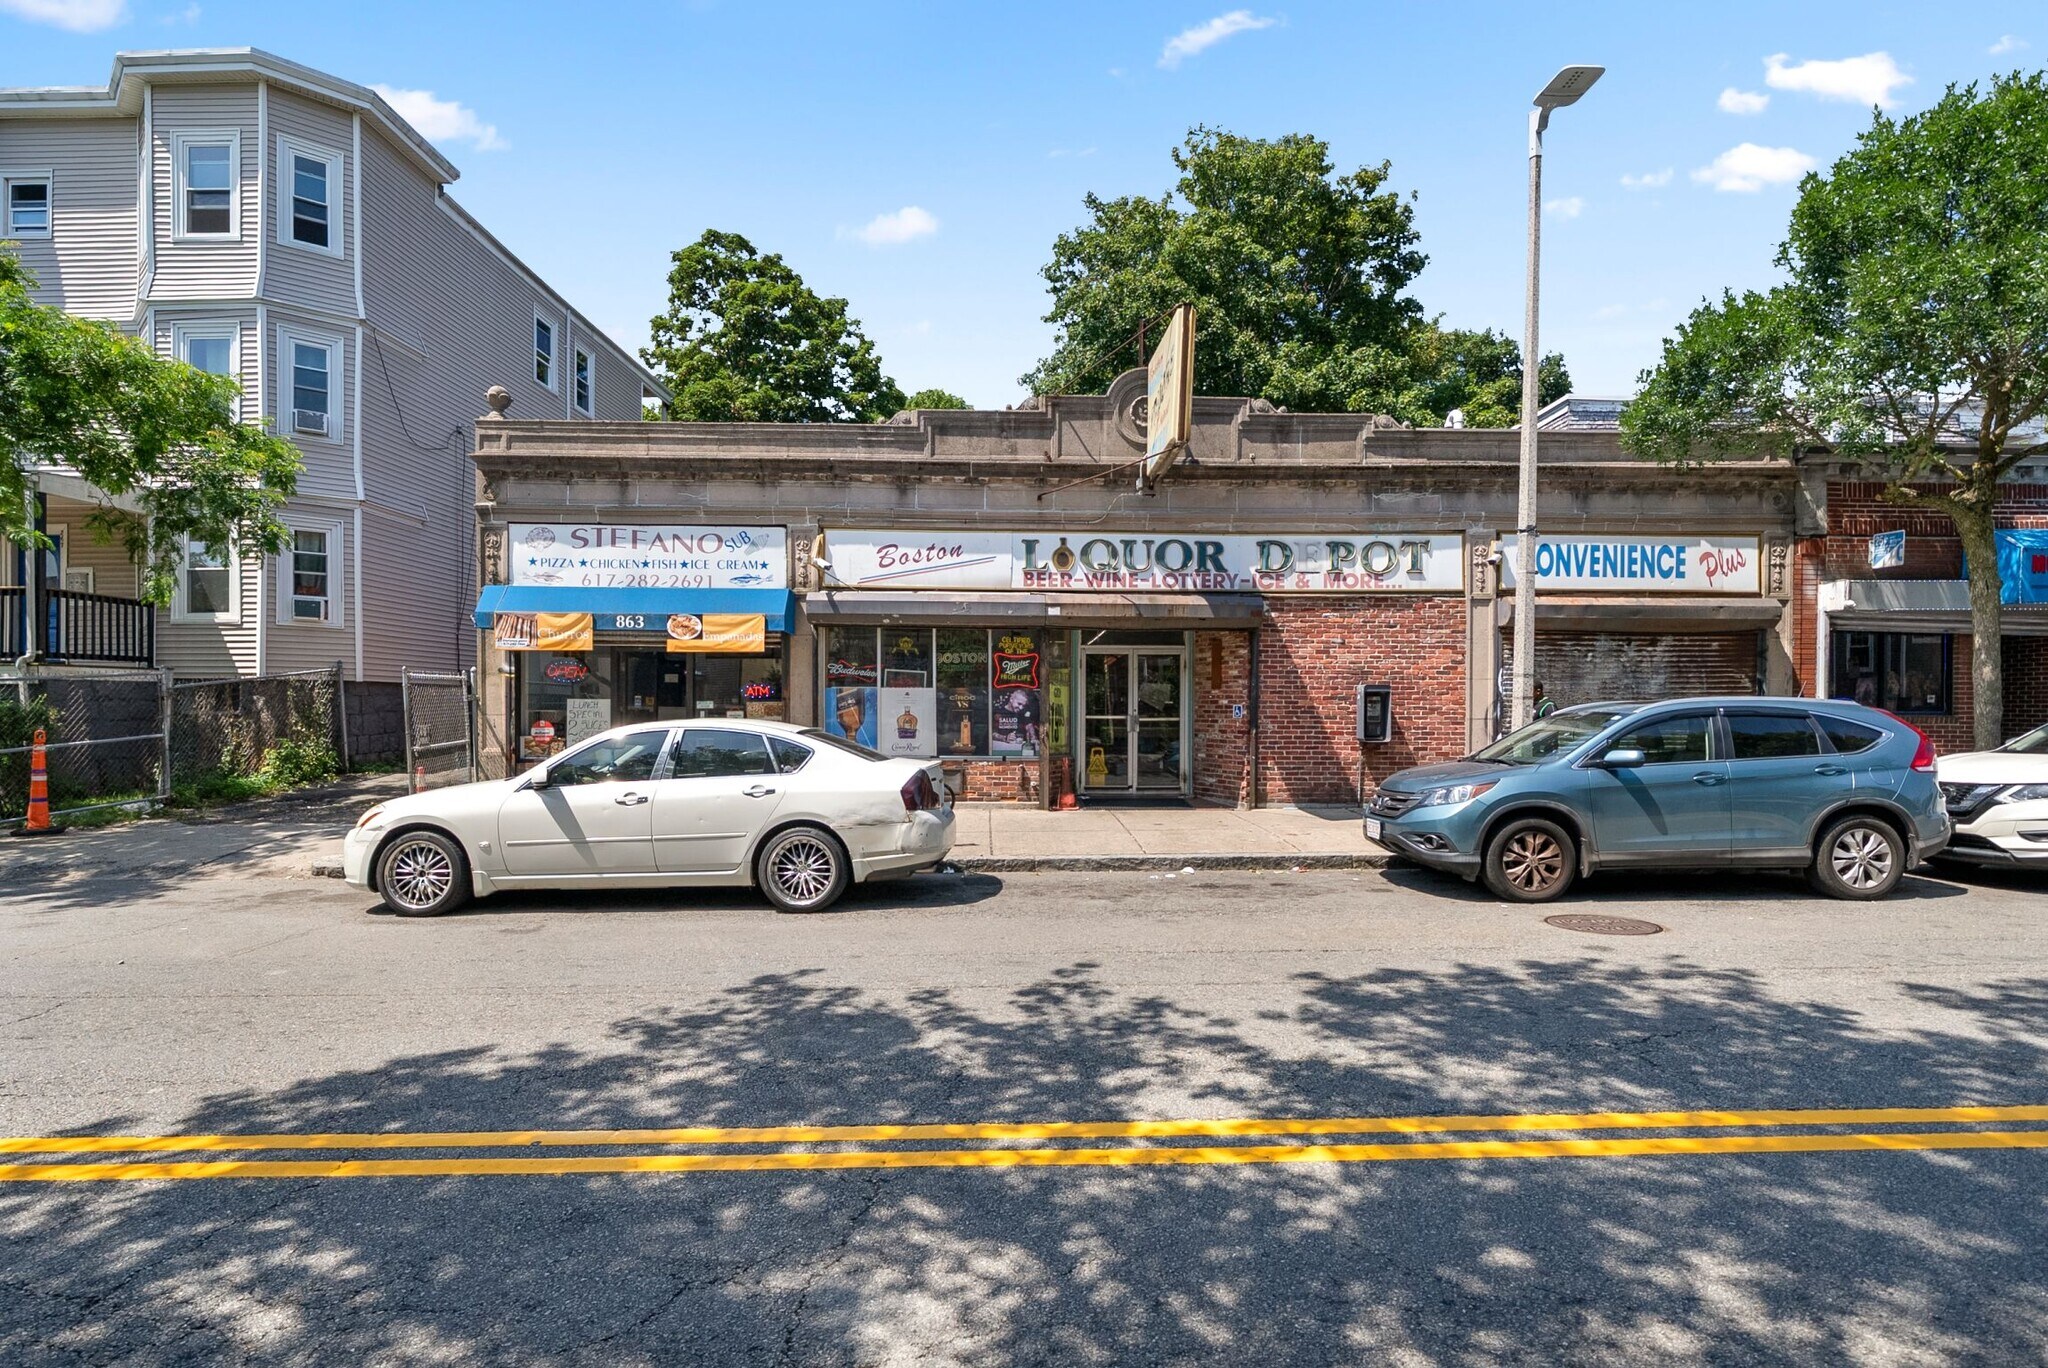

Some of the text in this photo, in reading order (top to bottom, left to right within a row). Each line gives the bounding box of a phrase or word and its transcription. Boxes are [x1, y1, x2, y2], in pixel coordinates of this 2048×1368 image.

[570, 527, 751, 555] STEFANO SUB
[876, 543, 964, 569] Boston
[540, 557, 759, 571] PIZZA CHICKEN FISH ICE CREAM
[1535, 543, 1746, 587] ONVENIENCE Plus
[581, 573, 713, 588] 617-282-2691
[1295, 574, 1310, 589] &
[616, 614, 645, 629] 863
[537, 627, 590, 640] Churros
[547, 665, 588, 679] OPEN
[746, 685, 770, 697] ATM
[572, 701, 599, 709] LUNCH
